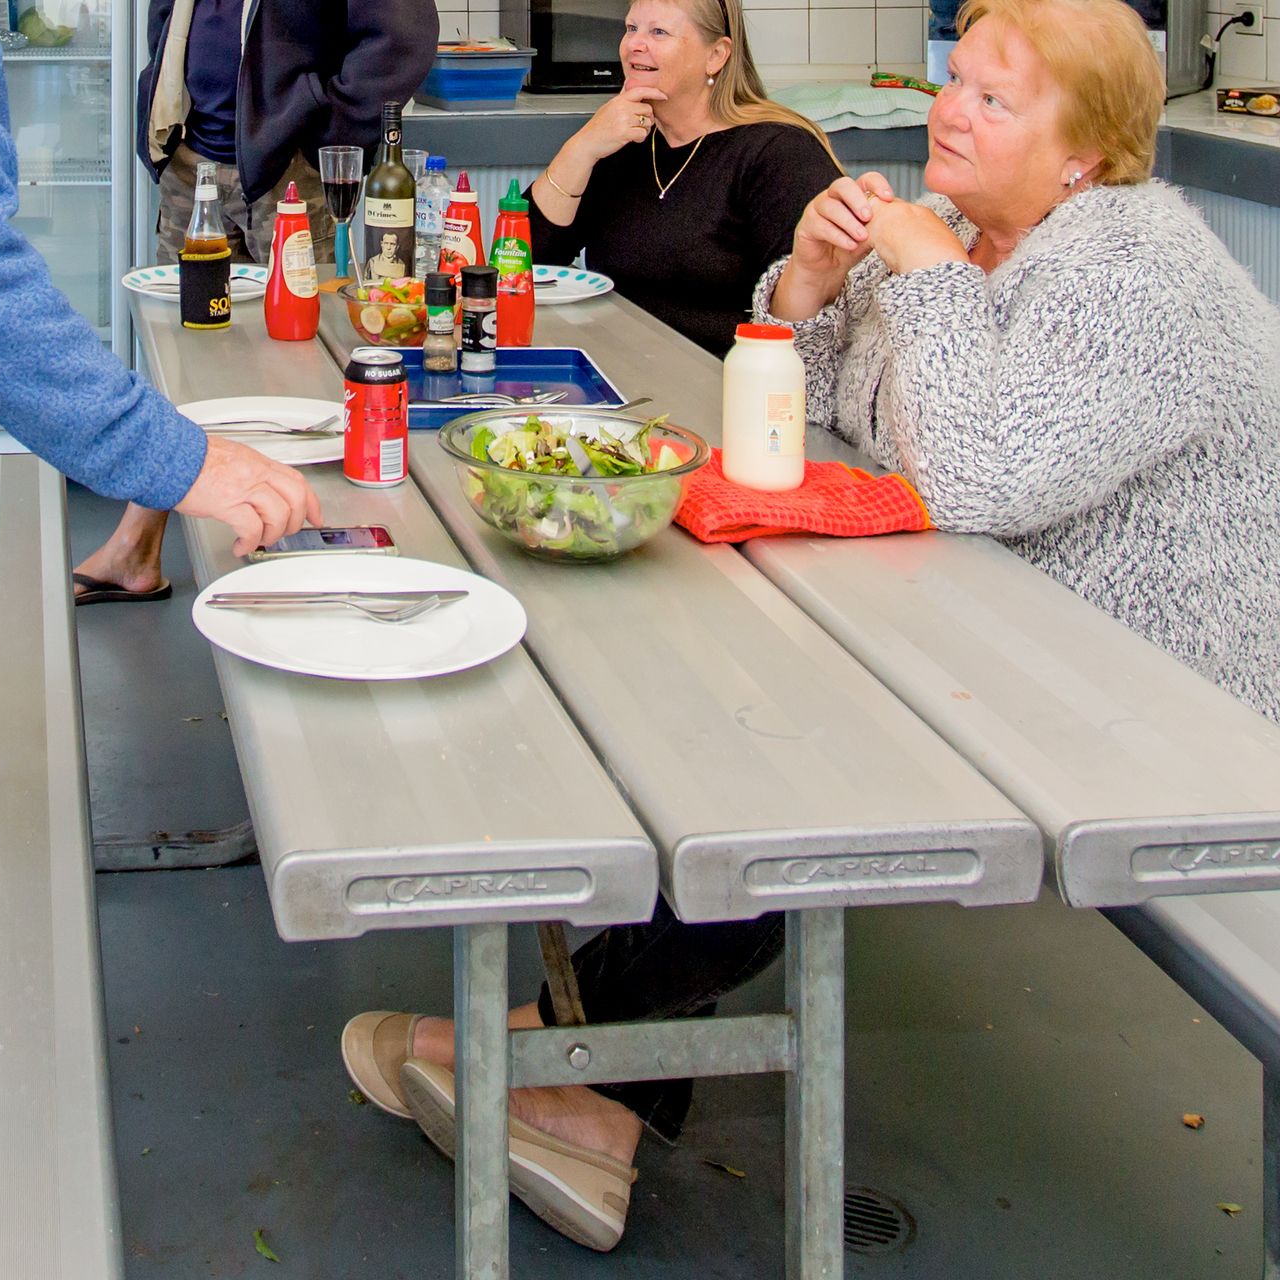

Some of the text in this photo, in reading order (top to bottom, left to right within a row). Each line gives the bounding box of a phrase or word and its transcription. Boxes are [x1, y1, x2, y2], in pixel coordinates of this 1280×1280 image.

[495, 248, 527, 258] Fountain
[209, 296, 231, 312] SQ
[364, 368, 402, 378] NO SUGAR
[781, 856, 937, 885] CAPRAL
[386, 871, 548, 904] CAPRAL
